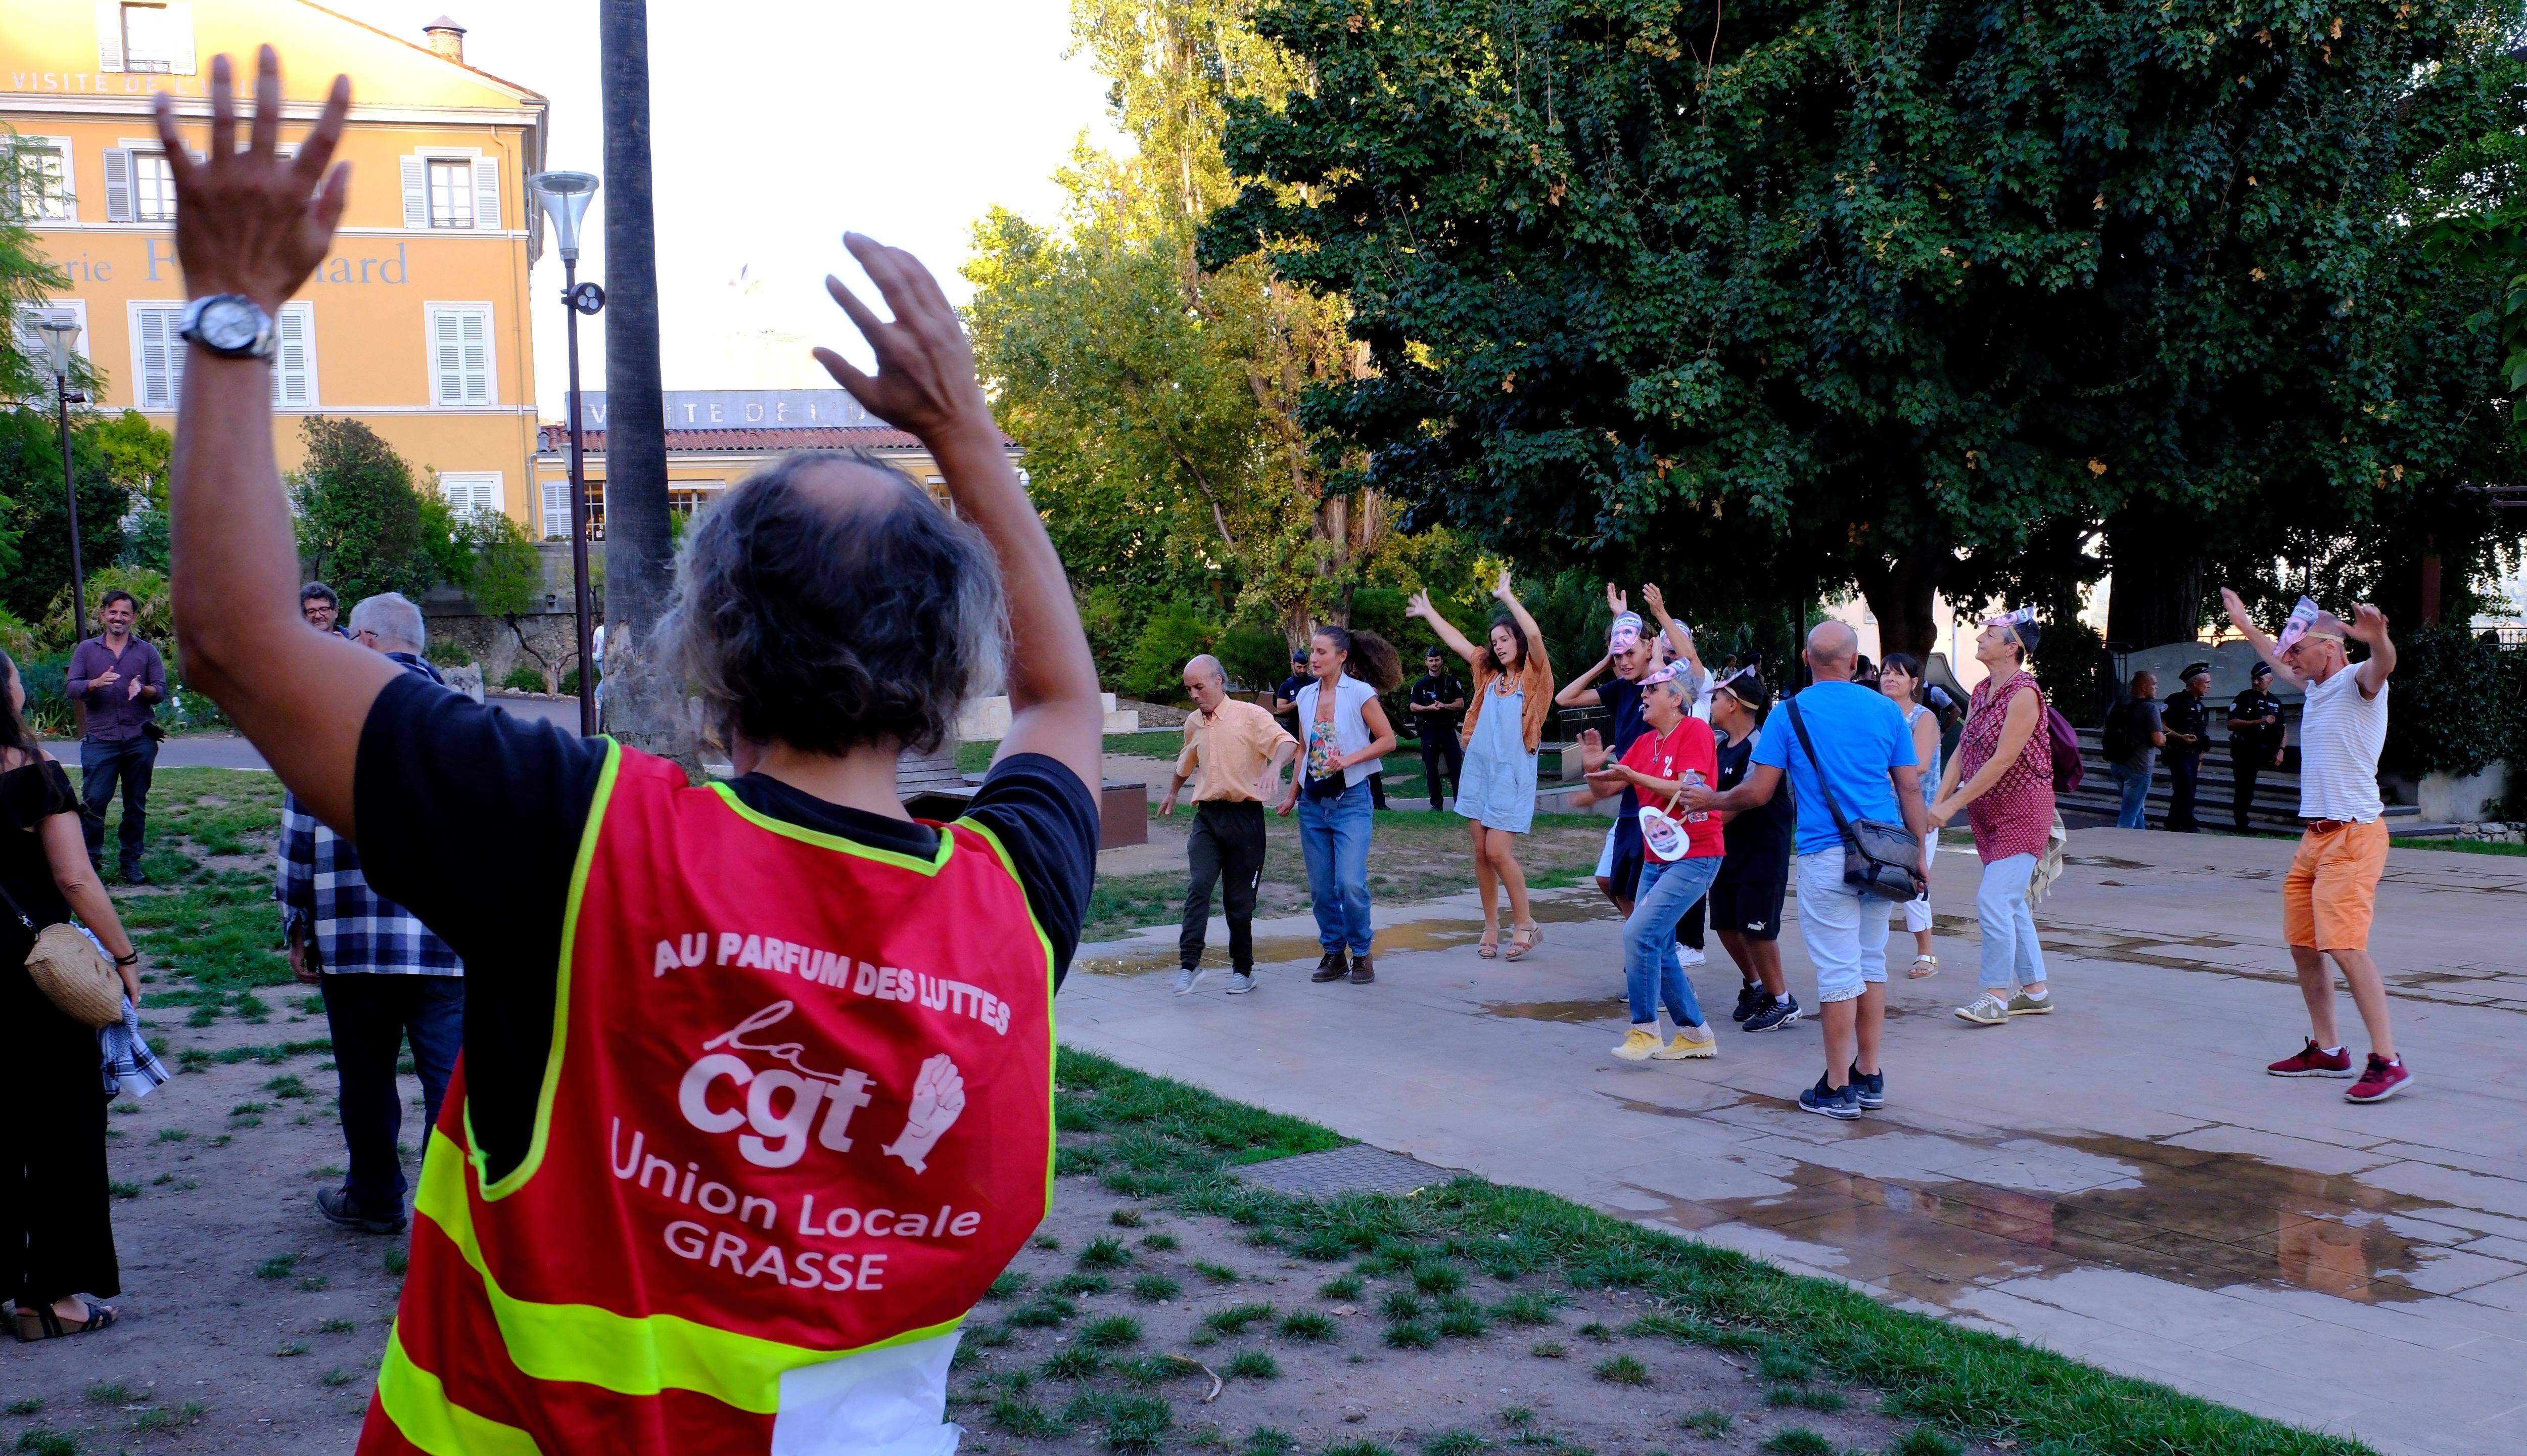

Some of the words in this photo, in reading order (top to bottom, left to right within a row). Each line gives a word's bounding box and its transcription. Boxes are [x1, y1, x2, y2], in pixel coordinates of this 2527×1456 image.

[12, 72, 109, 92] VISITE
[125, 75, 159, 93] DE
[588, 402, 724, 424] VITE
[653, 932, 708, 977] AU
[716, 932, 852, 989] PARFUM
[853, 962, 915, 1003] DES
[919, 972, 1011, 1036] LUTTES
[703, 1000, 846, 1081] la
[678, 1054, 876, 1168] cgt
[611, 1116, 776, 1230] Union
[797, 1194, 981, 1238] Locale
[663, 1219, 888, 1292] GRASSE
